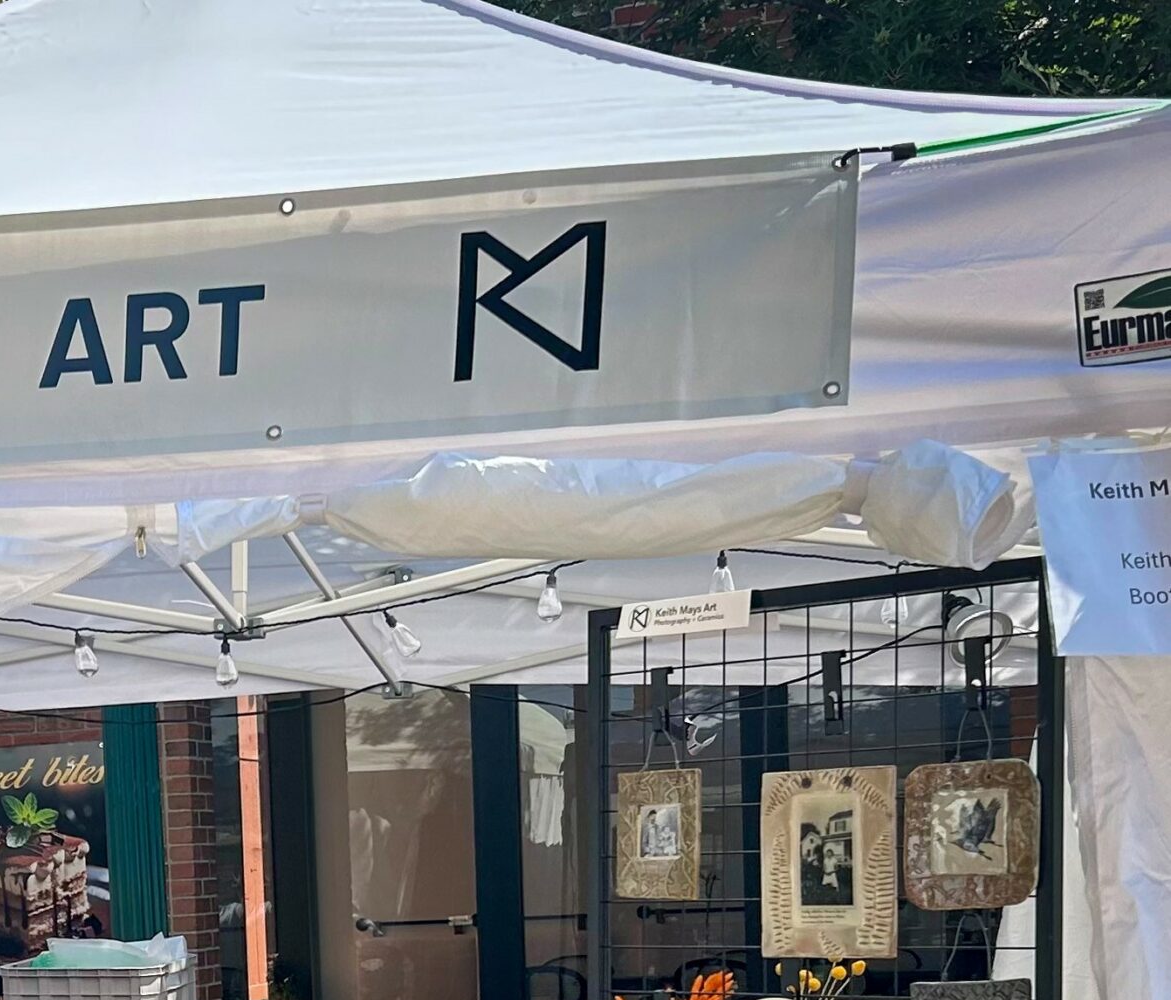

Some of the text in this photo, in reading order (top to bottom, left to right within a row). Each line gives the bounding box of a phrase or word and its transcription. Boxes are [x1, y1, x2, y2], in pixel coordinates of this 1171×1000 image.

[38, 284, 266, 389] ART
[1089, 482, 1144, 499] Keith
[1129, 587, 1171, 605] Boo
[654, 603, 717, 617] Keith Mays Art
[42, 754, 105, 788] bites
